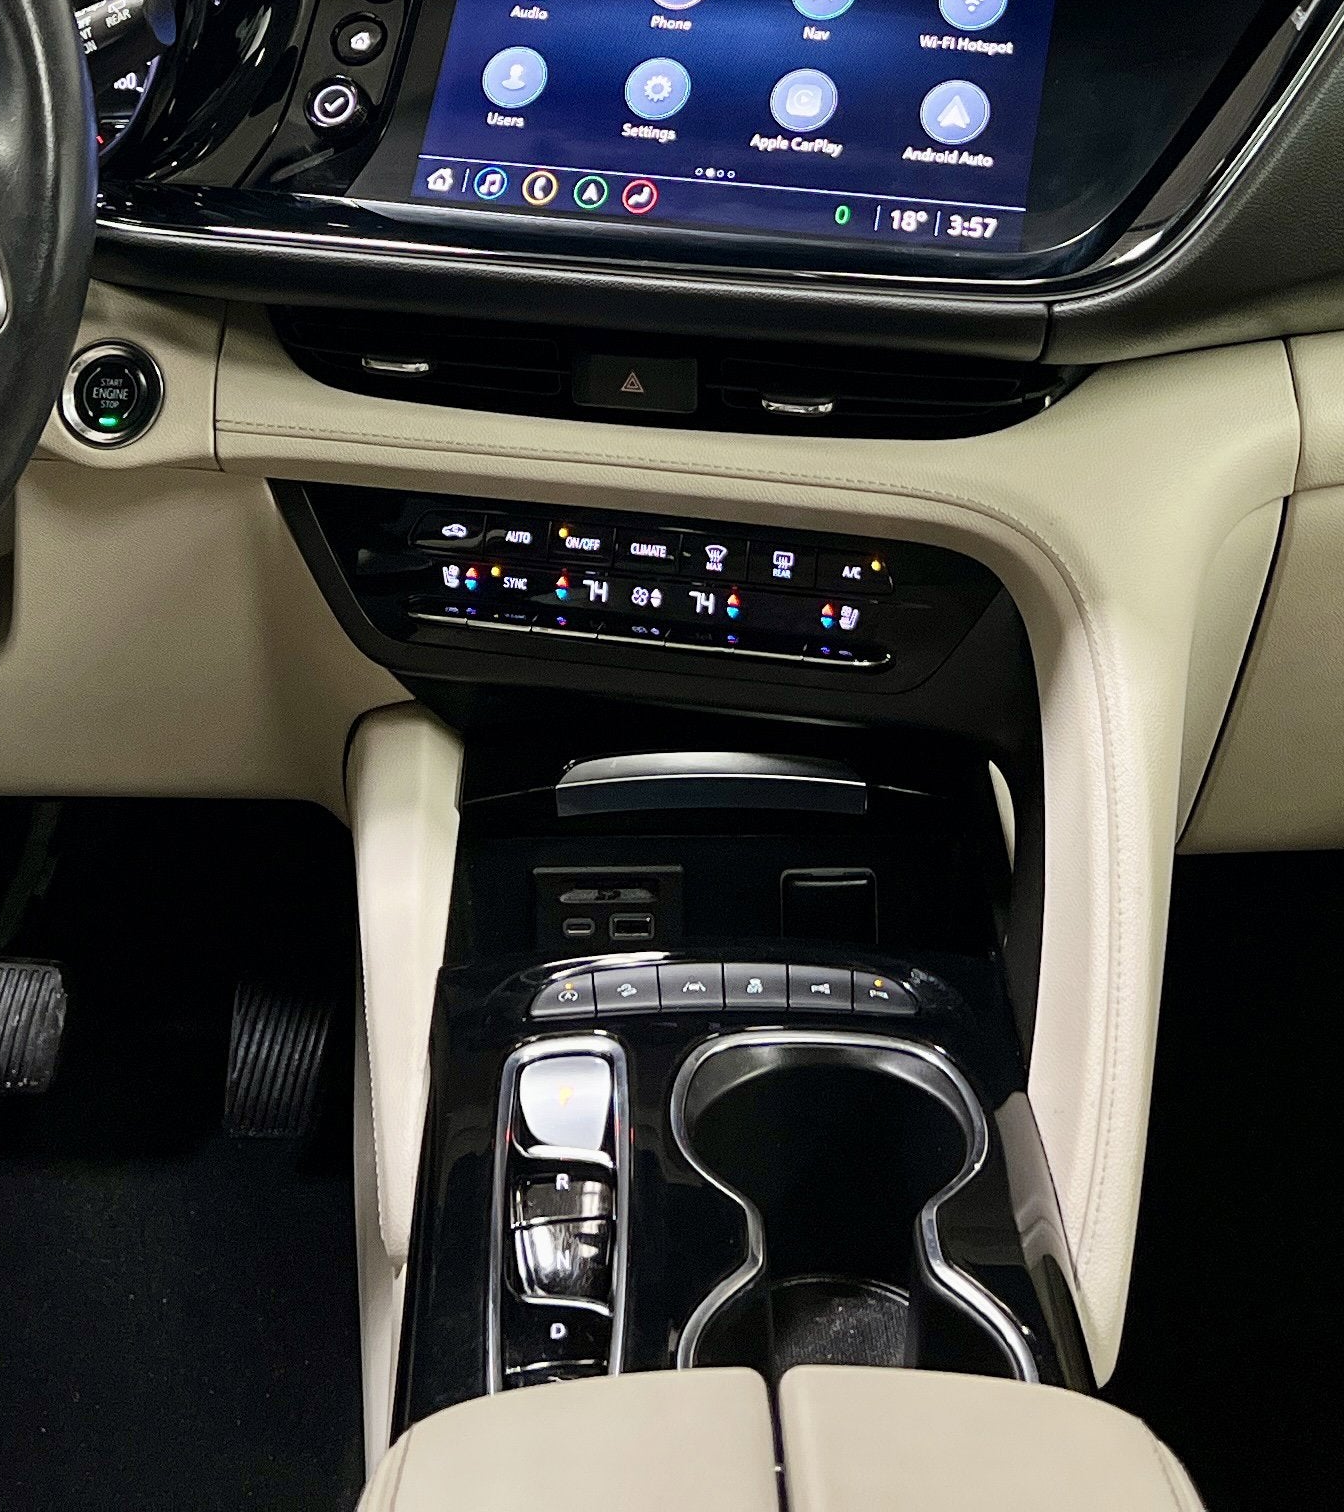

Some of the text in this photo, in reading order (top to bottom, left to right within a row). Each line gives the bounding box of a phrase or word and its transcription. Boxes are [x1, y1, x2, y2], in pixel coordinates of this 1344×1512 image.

[105, 8, 132, 29] REAR
[510, 5, 549, 21] Audio
[650, 14, 693, 31] Phone
[802, 26, 831, 41] Nav
[919, 34, 1014, 56] Wi-Fi Hotspot
[486, 112, 525, 128] Users
[621, 122, 677, 143] Settings
[749, 133, 844, 158] Apple CarPlay
[902, 146, 994, 168] Android Auto
[834, 204, 852, 226] 0
[890, 208, 929, 233] 18°
[946, 214, 999, 239] 3:57
[100, 378, 124, 387] START
[92, 387, 129, 400] ENGINE
[100, 399, 120, 409] STOP
[505, 530, 532, 544] AUTO
[565, 536, 601, 551] ON/OFF
[630, 542, 667, 559] CLIMATE
[706, 561, 723, 572] MAX
[842, 565, 862, 580] A/C
[503, 576, 528, 591] SYNC
[582, 578, 608, 603] 74
[688, 590, 716, 615] 74
[556, 1173, 569, 1190] R
[556, 1250, 570, 1270] N
[549, 1322, 567, 1340] D
